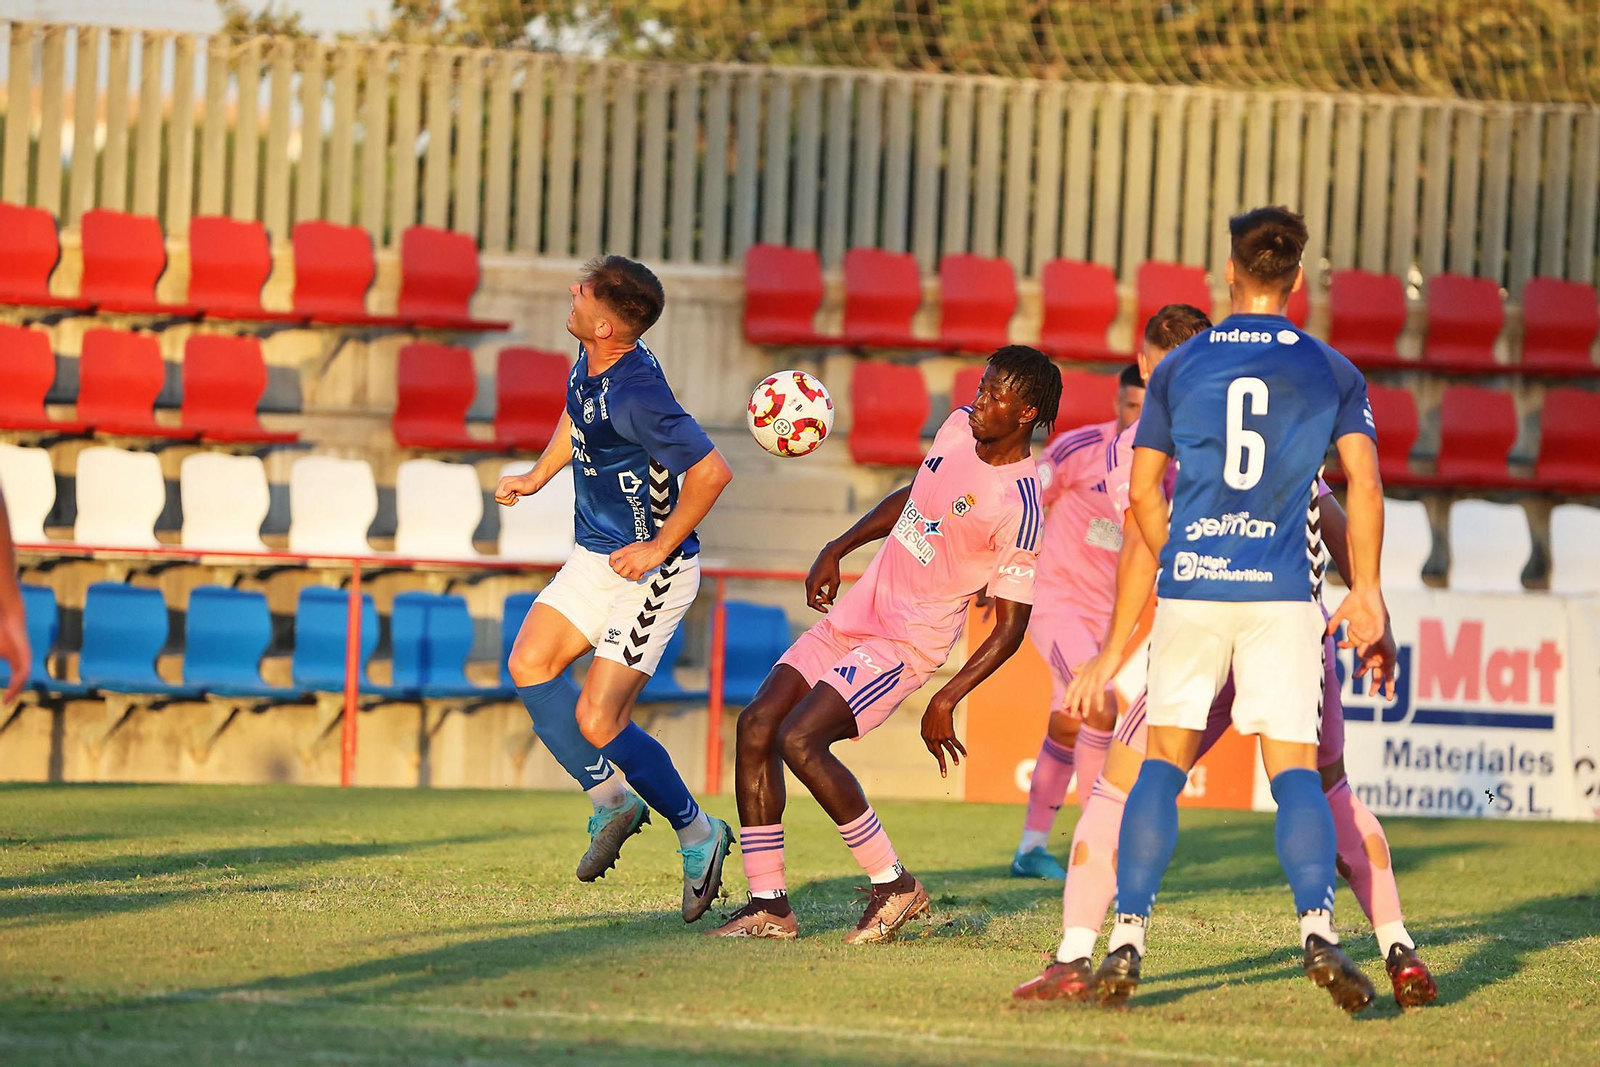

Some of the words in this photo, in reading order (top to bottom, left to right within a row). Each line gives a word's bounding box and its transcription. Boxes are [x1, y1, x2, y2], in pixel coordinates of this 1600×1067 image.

[1208, 328, 1272, 344] indeso
[1223, 377, 1269, 490] 6
[1198, 555, 1228, 570] High
[1195, 567, 1274, 582] ProNutrition
[1384, 738, 1554, 774] Materiales
